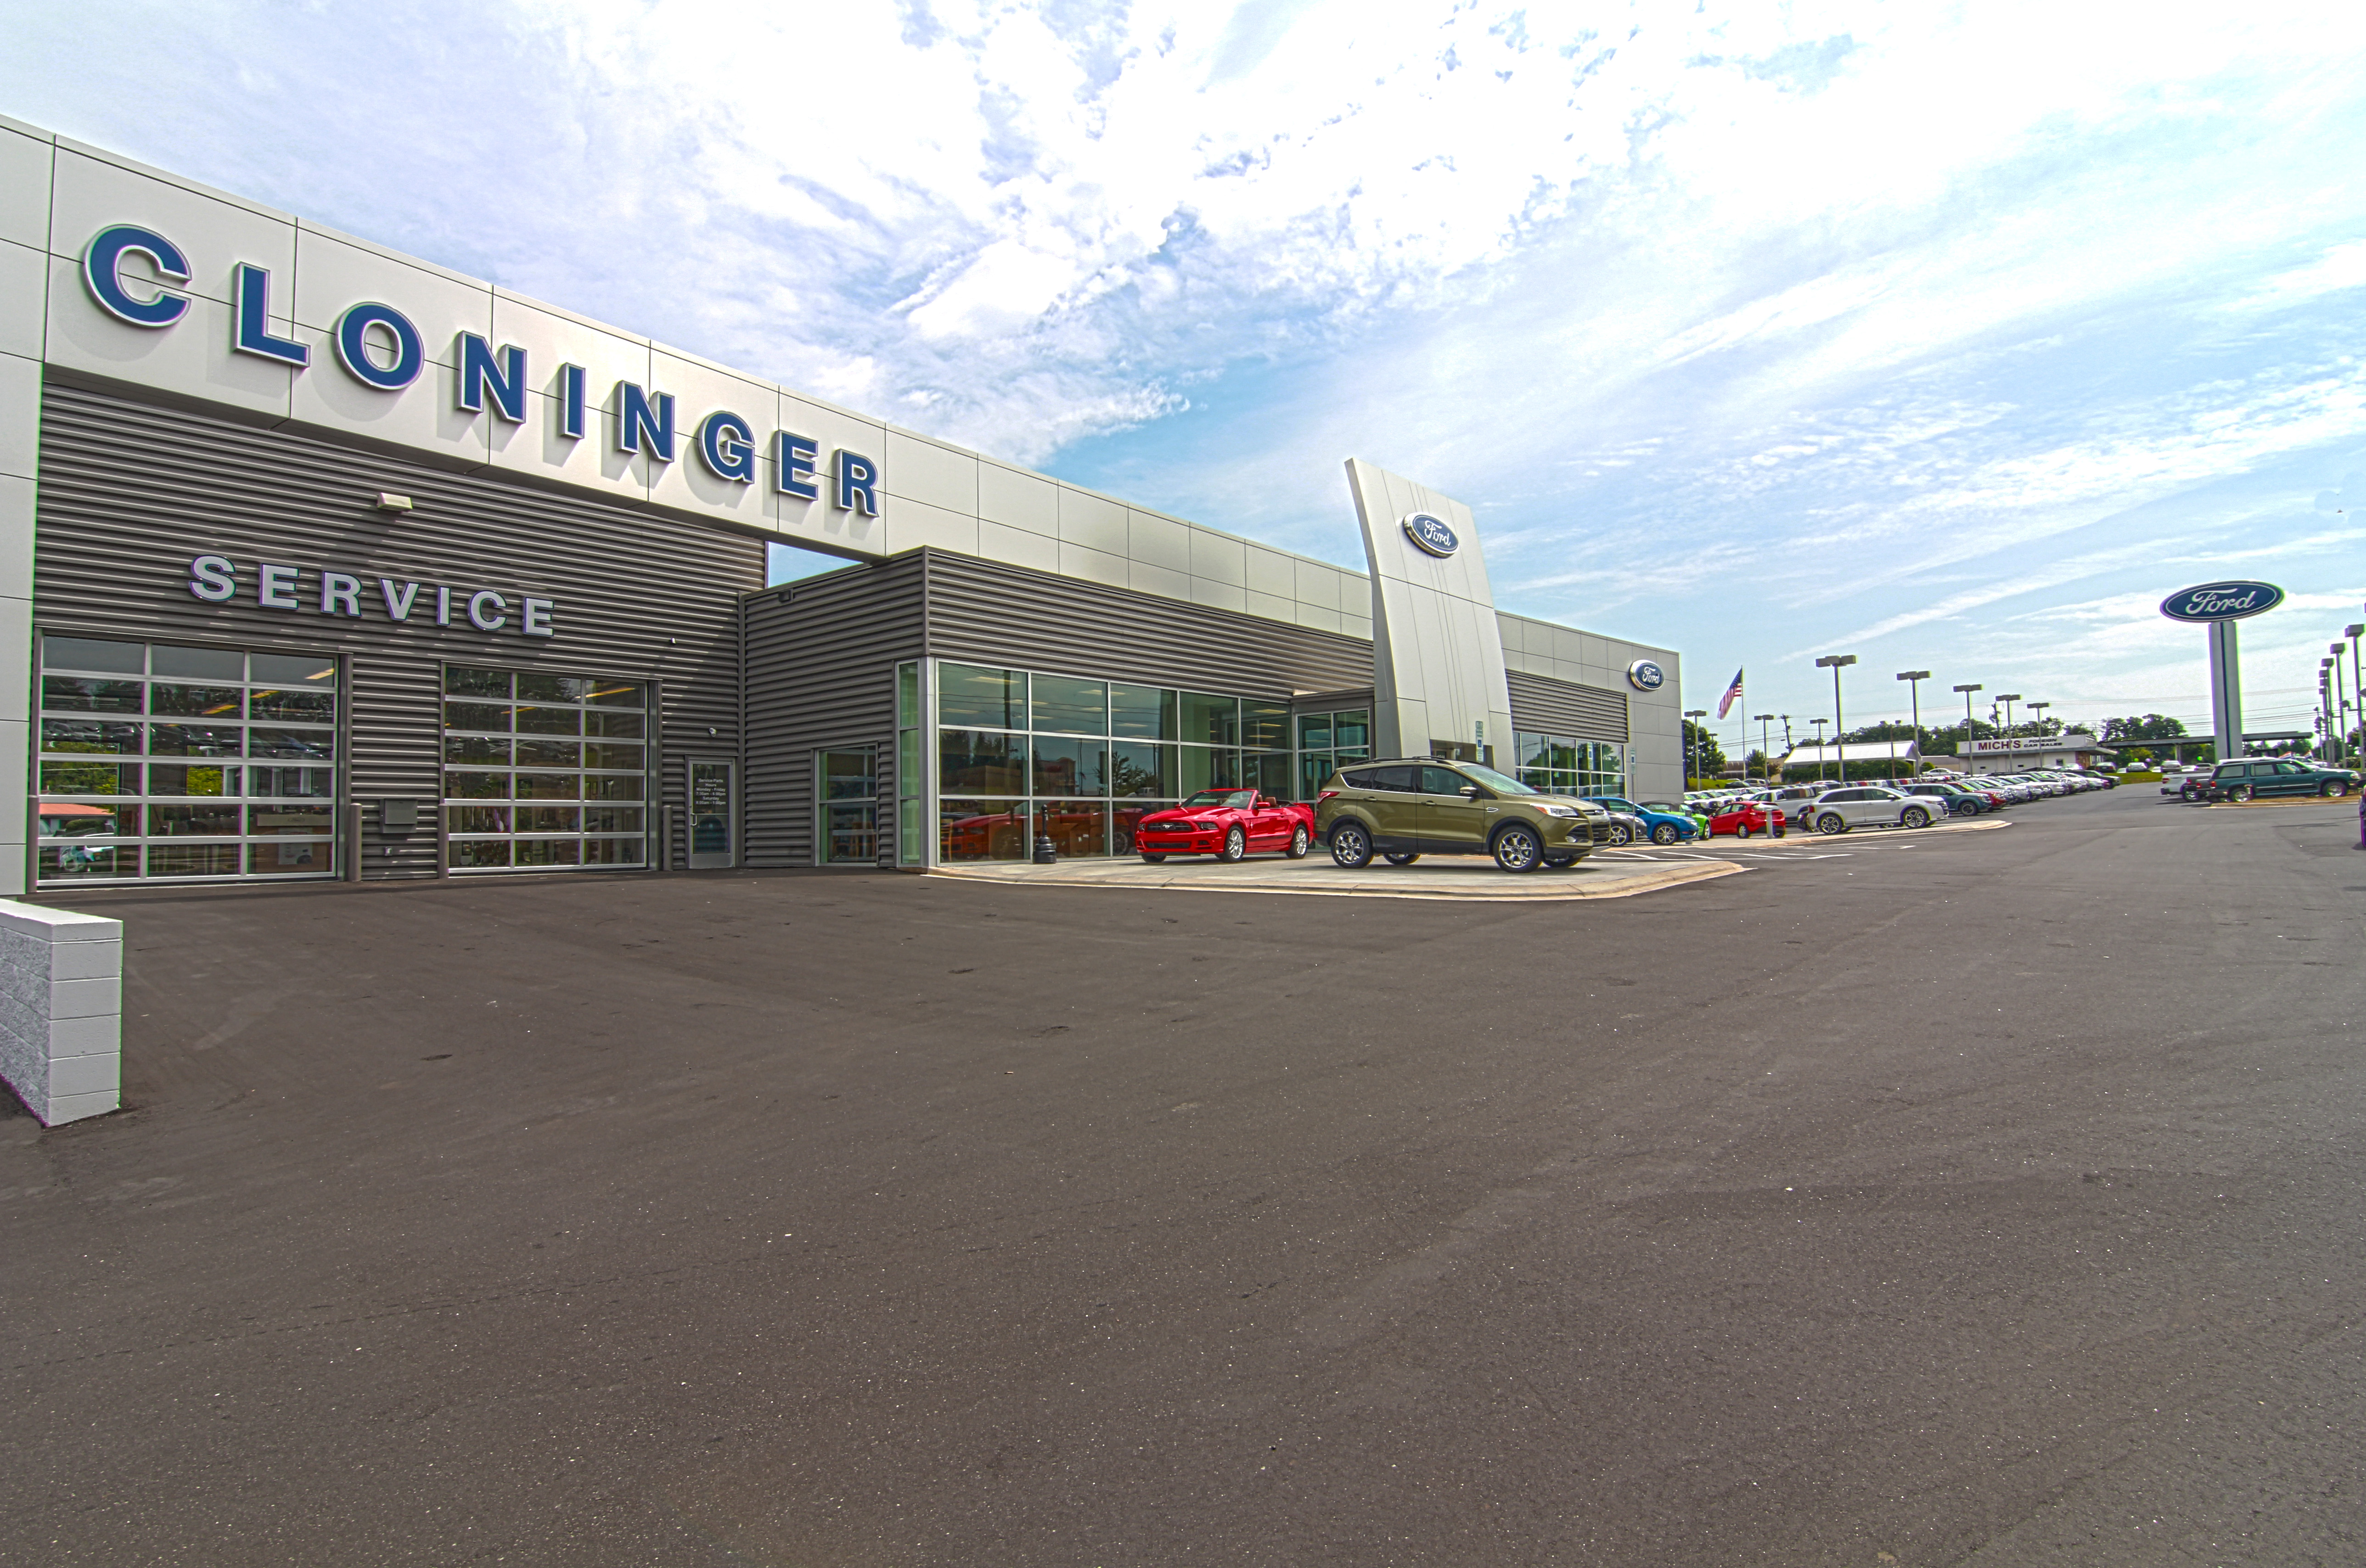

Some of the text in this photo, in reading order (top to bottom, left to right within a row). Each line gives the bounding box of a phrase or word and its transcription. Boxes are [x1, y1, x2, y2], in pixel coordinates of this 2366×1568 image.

[83, 224, 879, 517] CLONINGER
[1424, 520, 1451, 546] Ford
[189, 555, 555, 637] SERVICE
[2185, 588, 2257, 615] Ford
[1642, 667, 1660, 684] Ford
[1978, 740, 2021, 750] MICH'S
